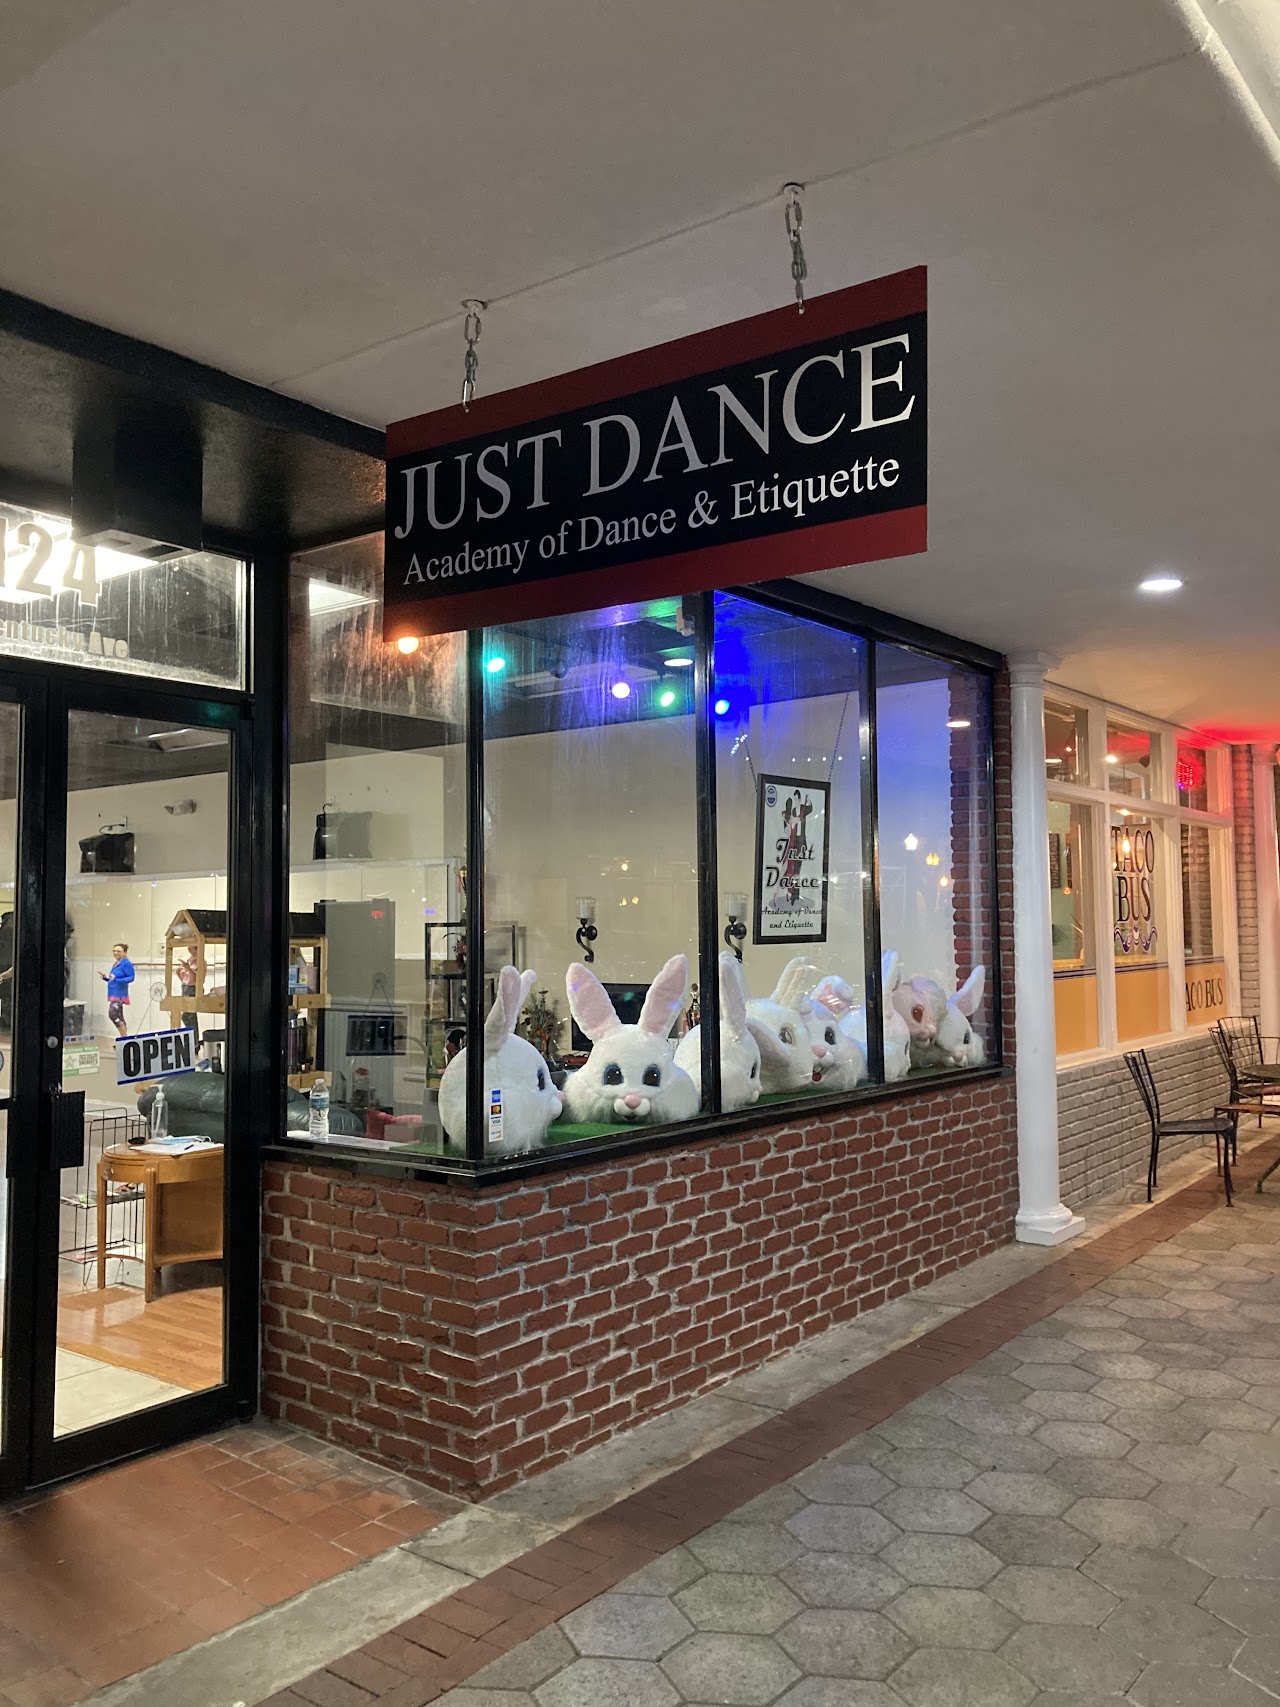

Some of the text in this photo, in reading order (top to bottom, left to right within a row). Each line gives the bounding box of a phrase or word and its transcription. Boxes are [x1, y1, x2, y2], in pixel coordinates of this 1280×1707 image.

[395, 333, 915, 538] JUST DANCE
[403, 456, 899, 585] Academy of Dance & Etiquette
[88, 631, 129, 659] Ave
[776, 838, 815, 863] Just
[1111, 825, 1155, 873] TACO
[765, 866, 819, 888] Dance
[1116, 875, 1152, 922] BUS
[769, 919, 814, 930] and Etiquette
[1205, 977, 1224, 1009] BUS
[122, 1034, 191, 1077] OPEN
